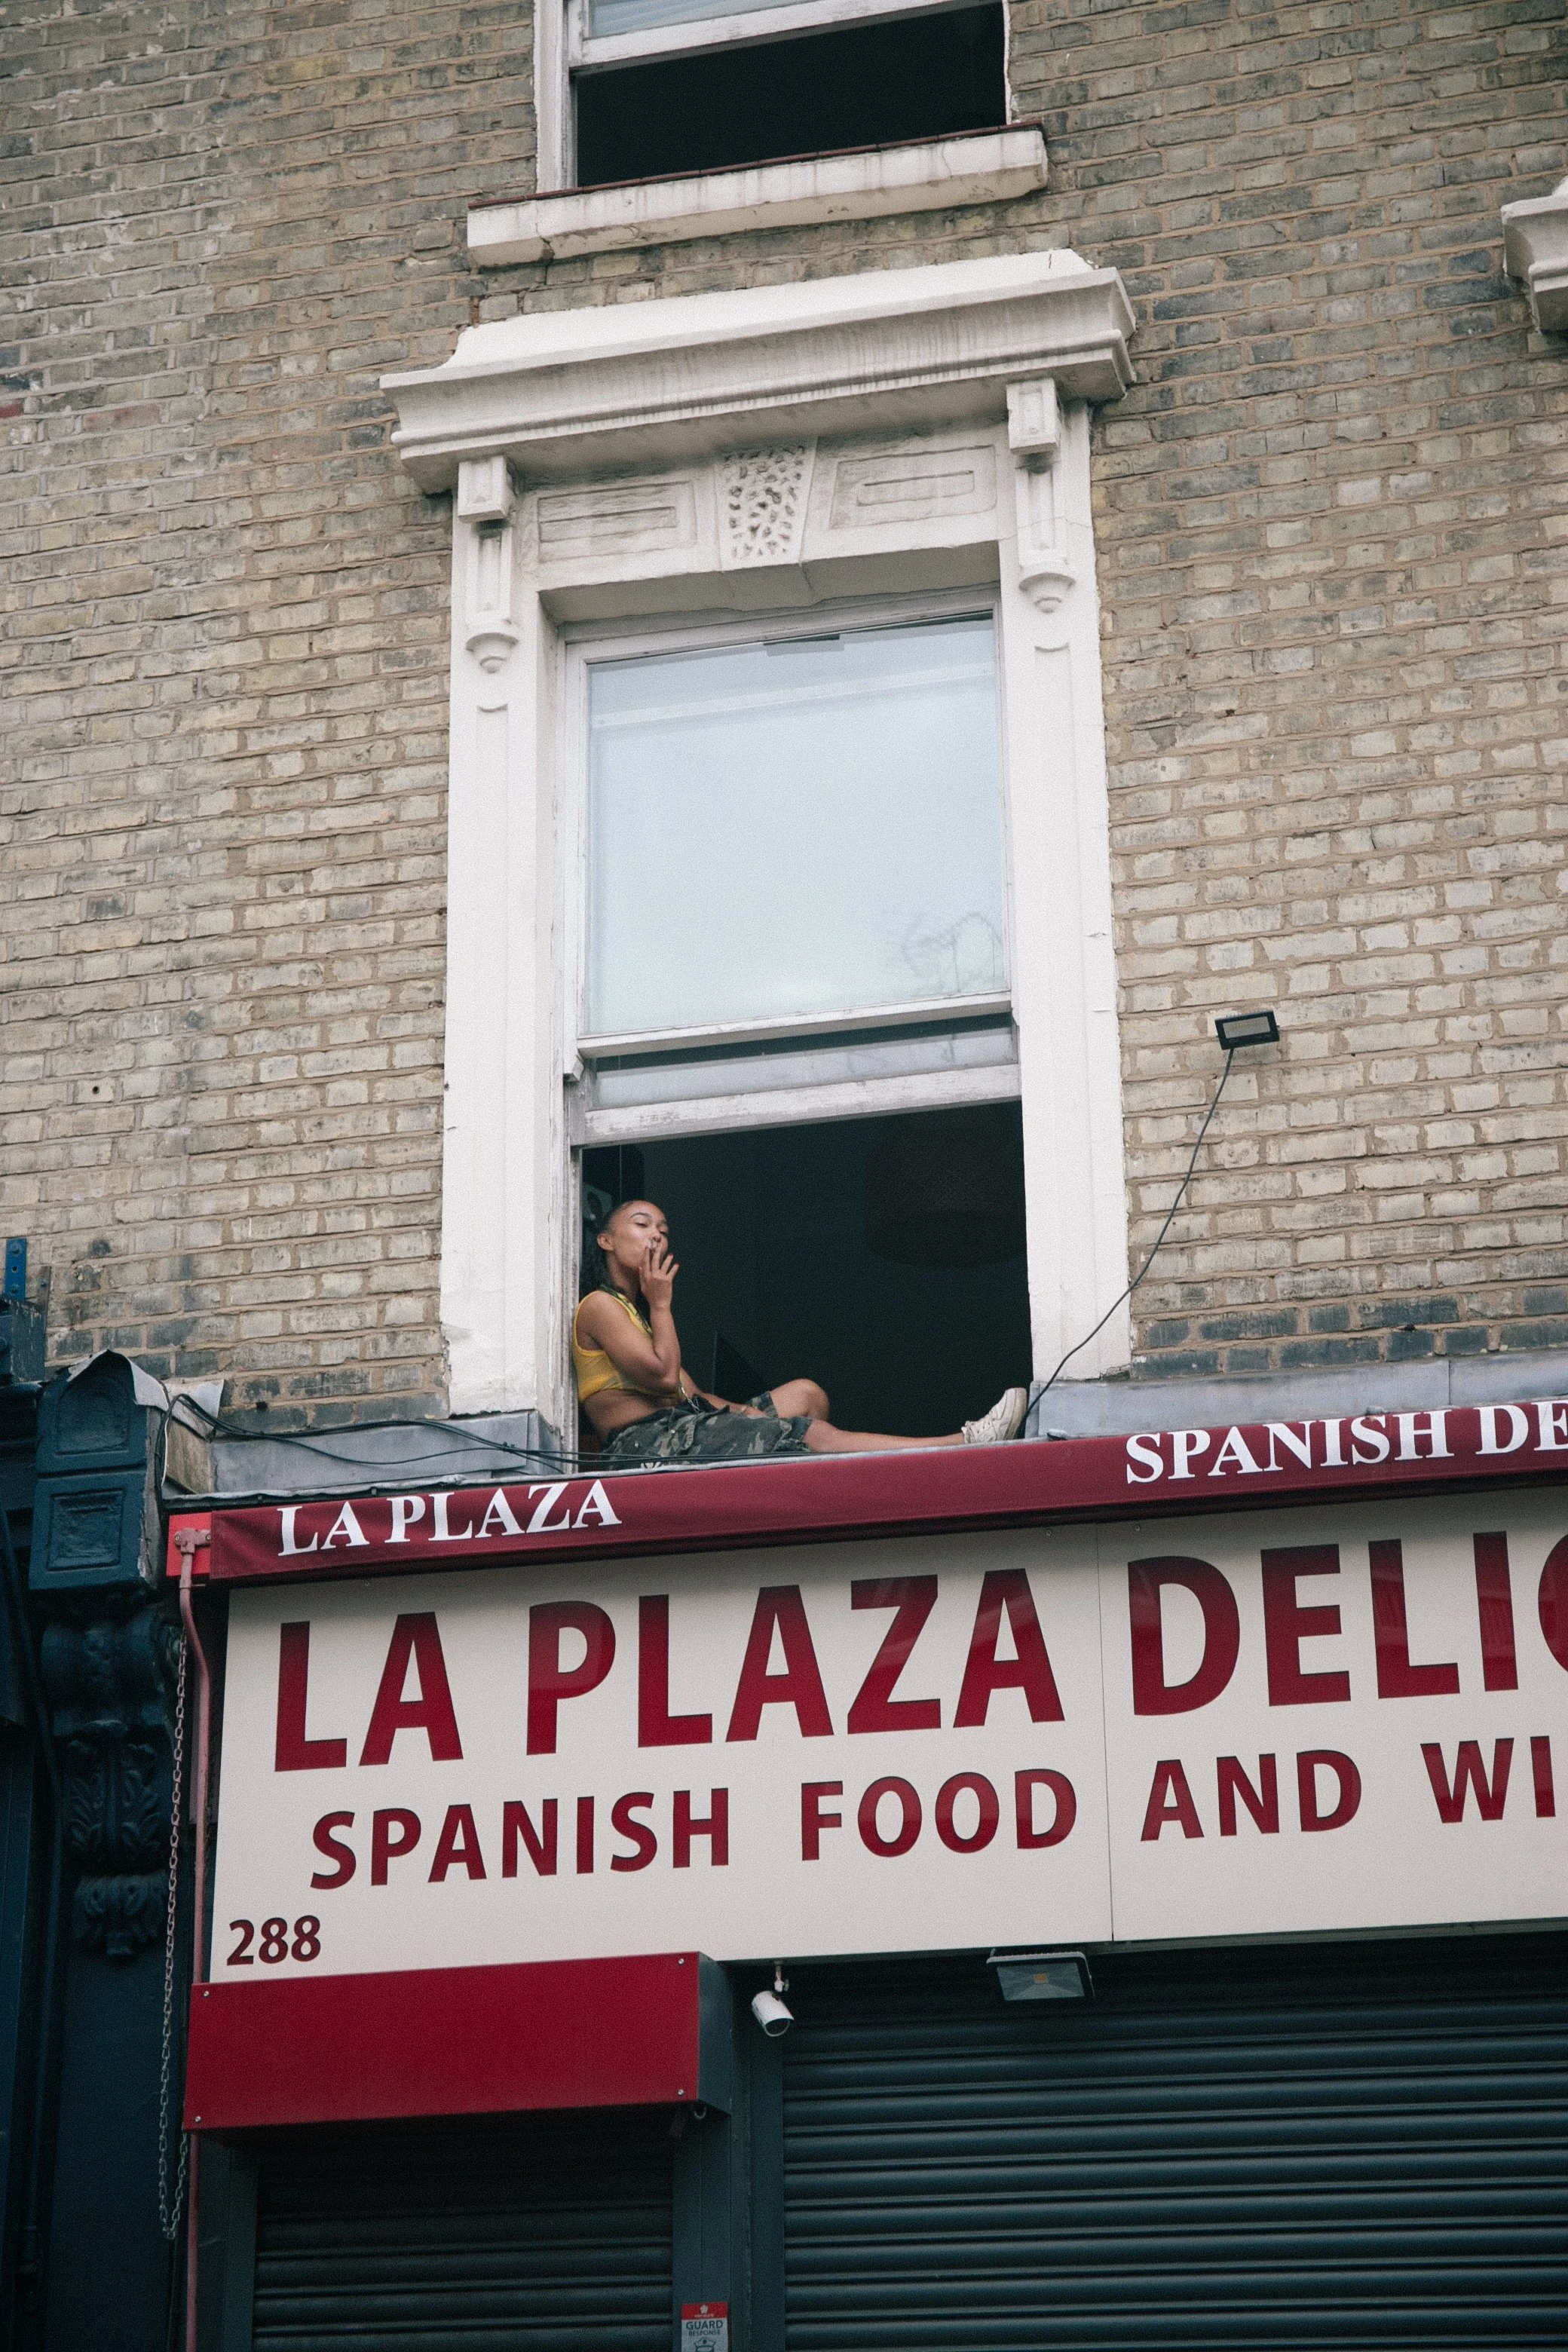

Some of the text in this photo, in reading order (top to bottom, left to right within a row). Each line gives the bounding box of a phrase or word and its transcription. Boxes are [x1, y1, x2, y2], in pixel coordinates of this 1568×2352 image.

[1125, 1398, 1568, 1484] SPANISH DE
[277, 1478, 622, 1557] LA PLAZA
[274, 1611, 464, 1772] LA
[526, 1567, 1065, 1756] PLAZA
[310, 1735, 1557, 1890] SPANISH FOOD AND WI
[226, 1915, 322, 1966] 288
[686, 2320, 724, 2330] GUARD
